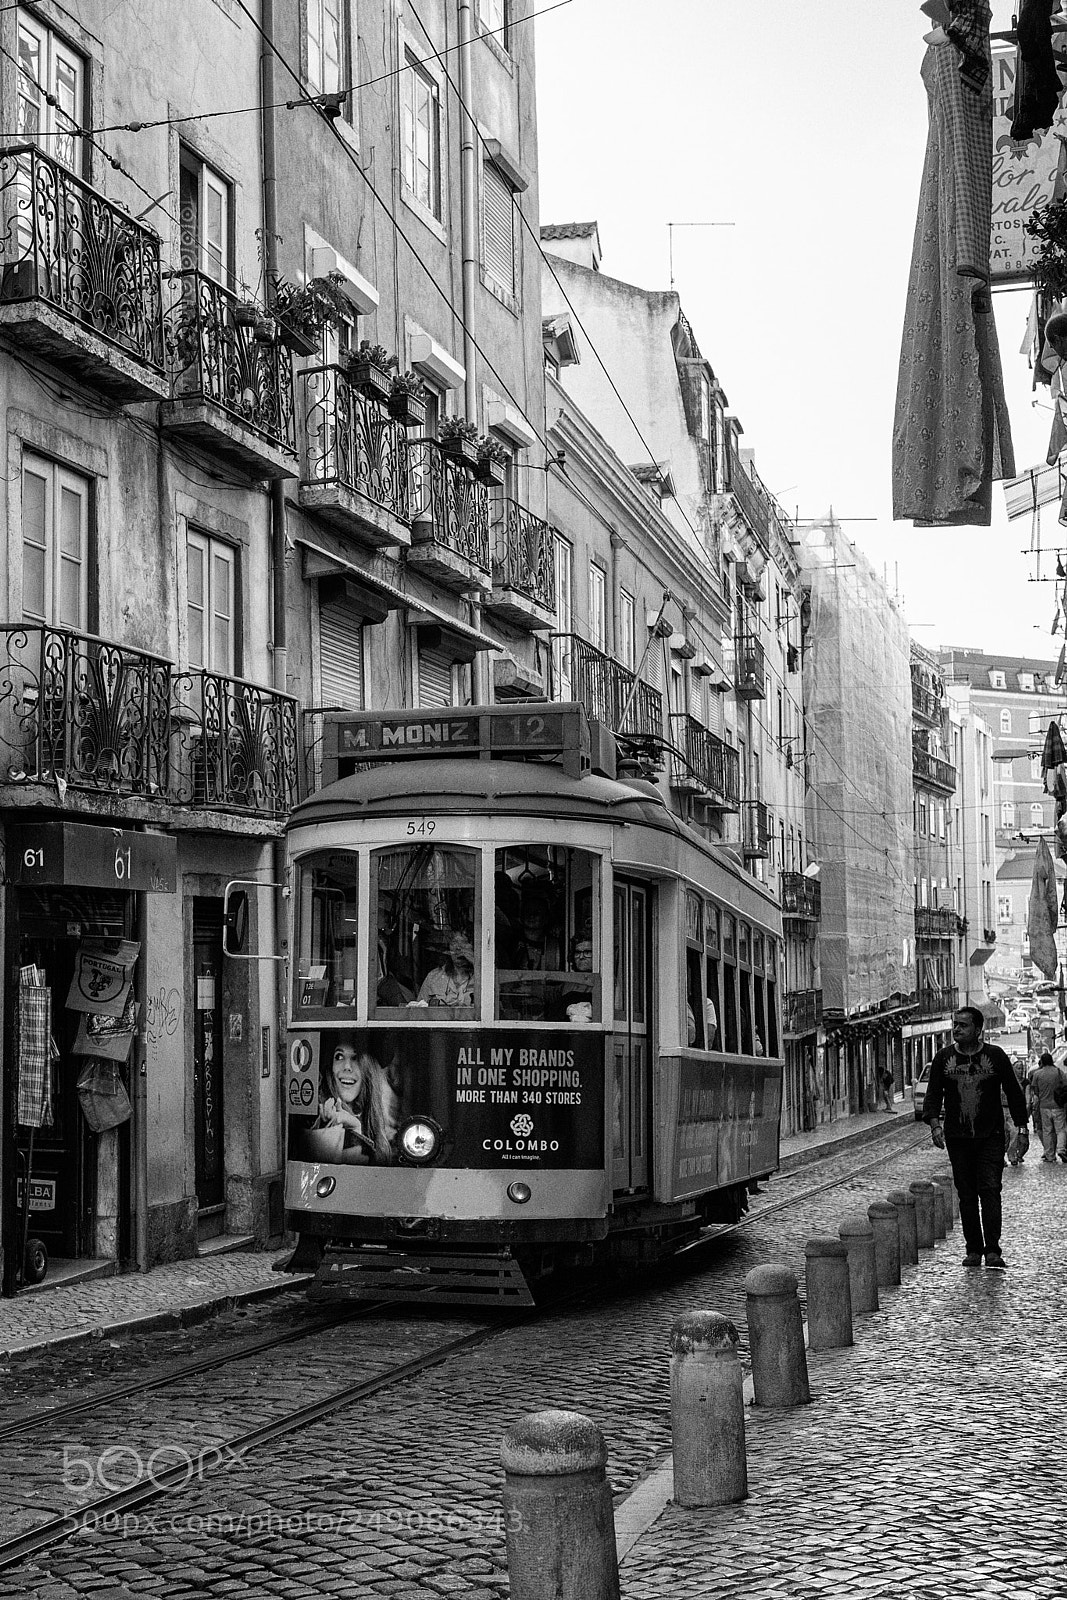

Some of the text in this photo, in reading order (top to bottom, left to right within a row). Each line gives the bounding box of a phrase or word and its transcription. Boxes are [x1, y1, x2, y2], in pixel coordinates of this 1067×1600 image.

[343, 721, 469, 748] M. MONIZ
[509, 716, 546, 743] 12
[406, 820, 436, 836] 549
[24, 847, 45, 868] 61
[114, 846, 132, 880] 61
[83, 957, 122, 973] PORTUGAL
[457, 1047, 575, 1067] ALL MY BRANDS
[456, 1067, 583, 1088] IN ONE SHOPPING.
[456, 1089, 582, 1105] MORE THAN 340 STORES
[482, 1139, 559, 1151] COLOMBO
